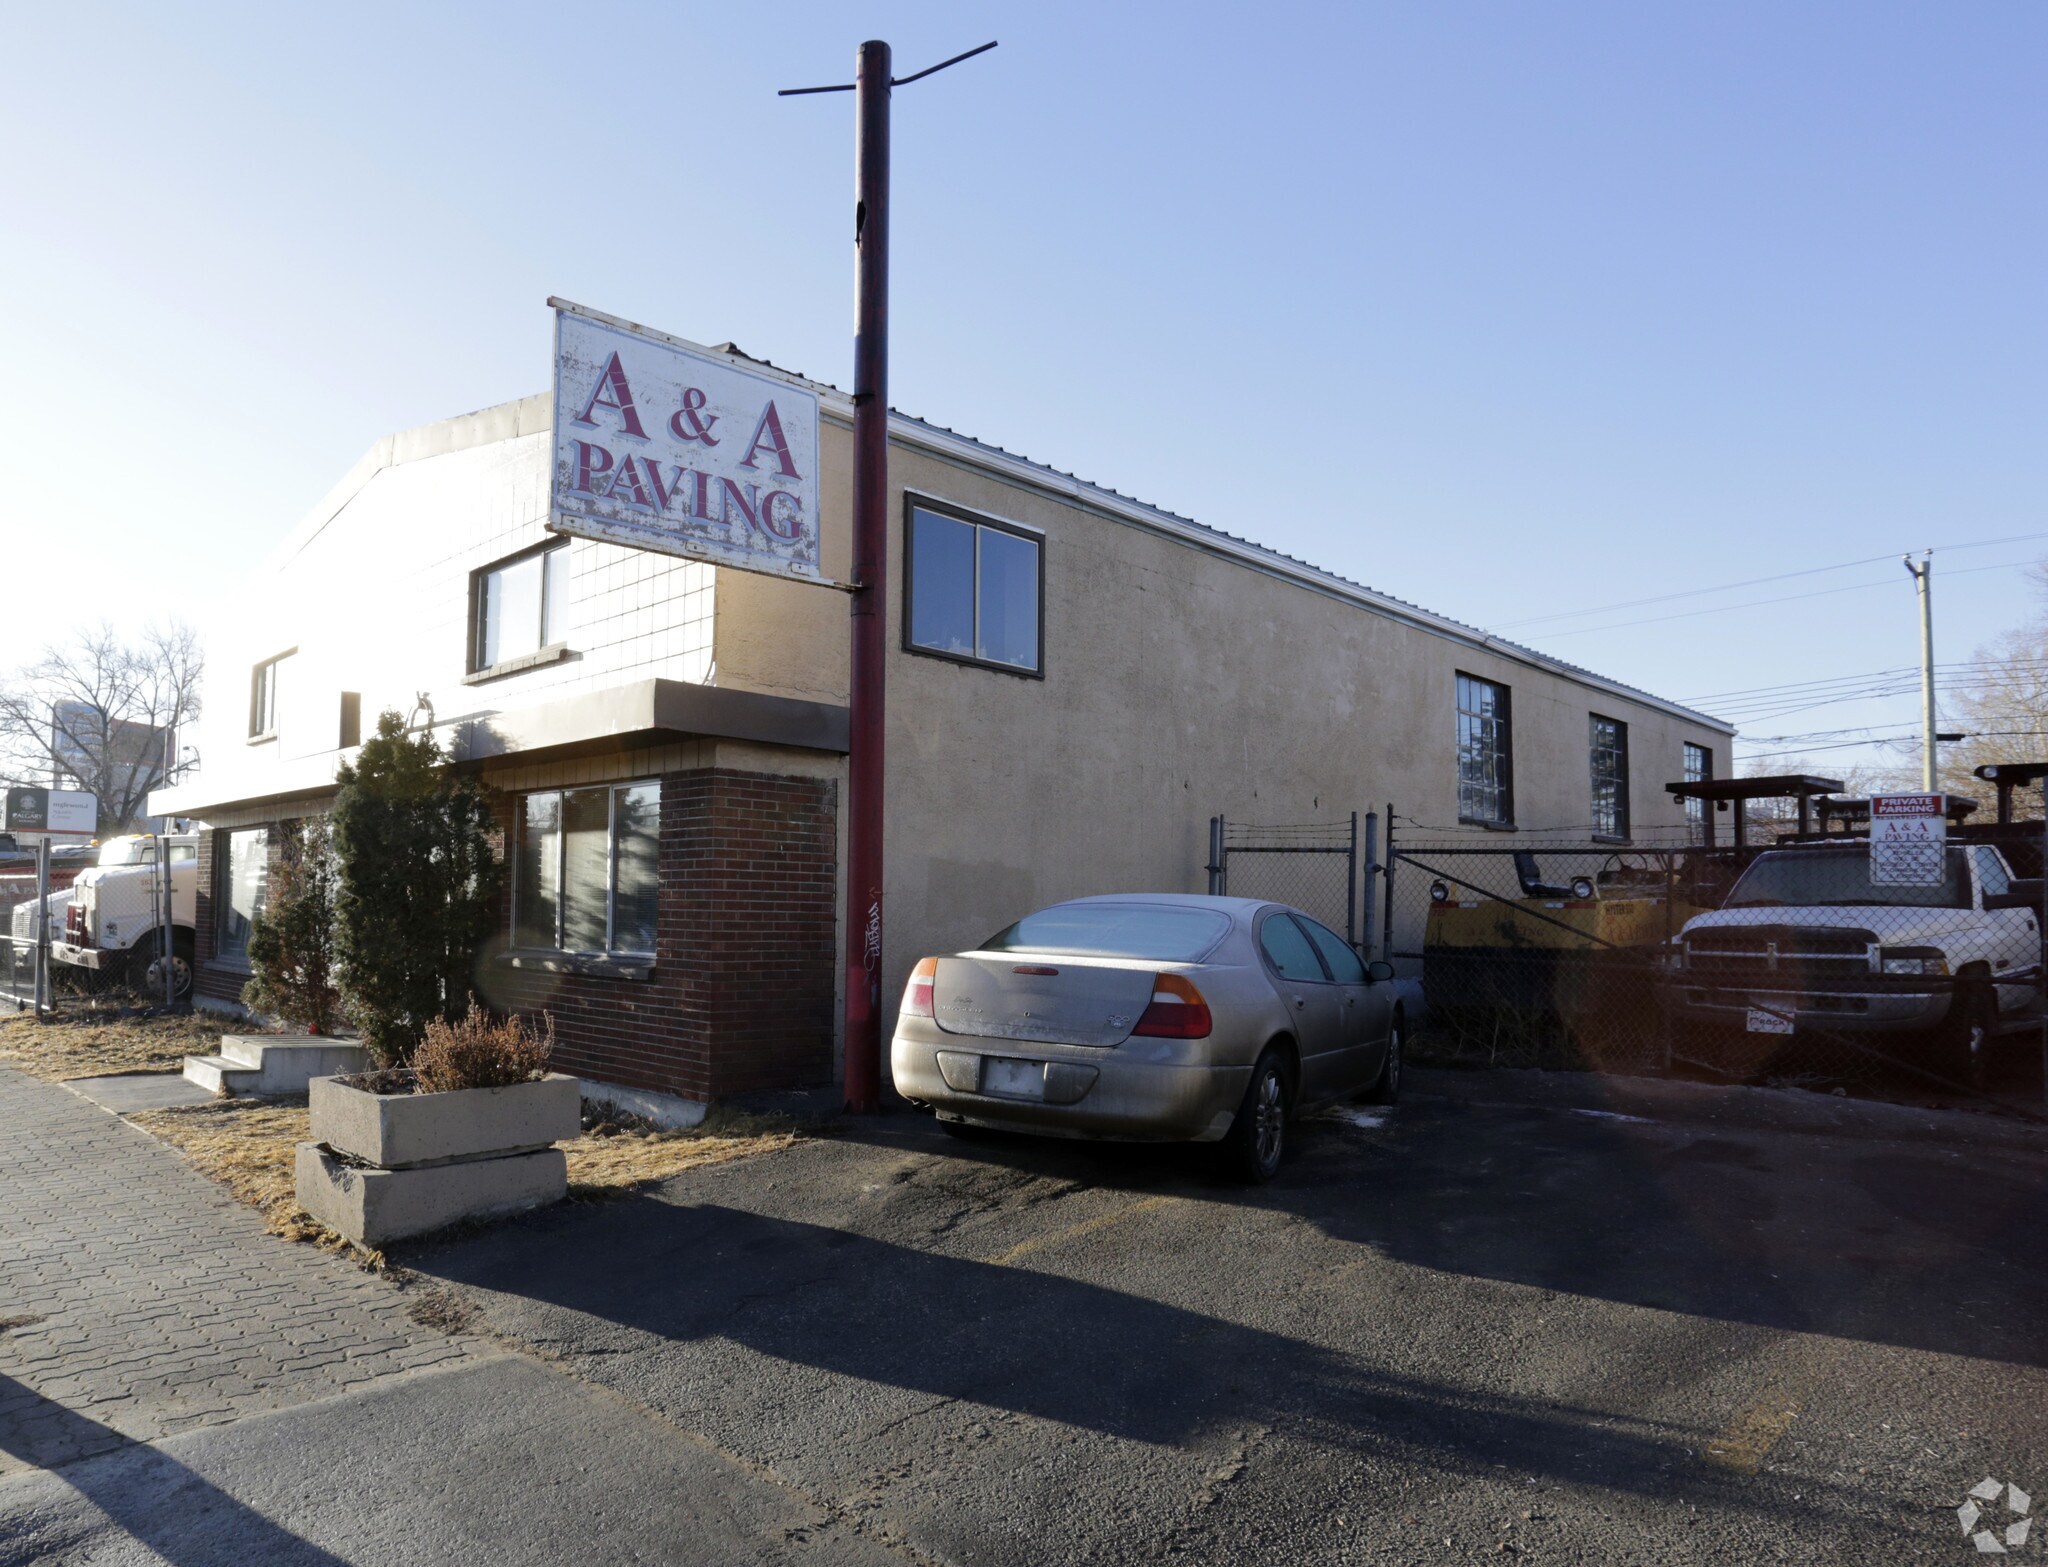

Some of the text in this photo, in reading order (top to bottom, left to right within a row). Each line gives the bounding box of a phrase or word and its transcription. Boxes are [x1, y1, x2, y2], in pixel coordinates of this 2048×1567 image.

[574, 350, 803, 481] A & A
[570, 438, 803, 542] PAVING
[1881, 797, 1933, 805] PRIVATE
[1878, 804, 1935, 814] PARKING
[1885, 820, 1929, 833] A & A
[1884, 832, 1930, 841] PAVING
